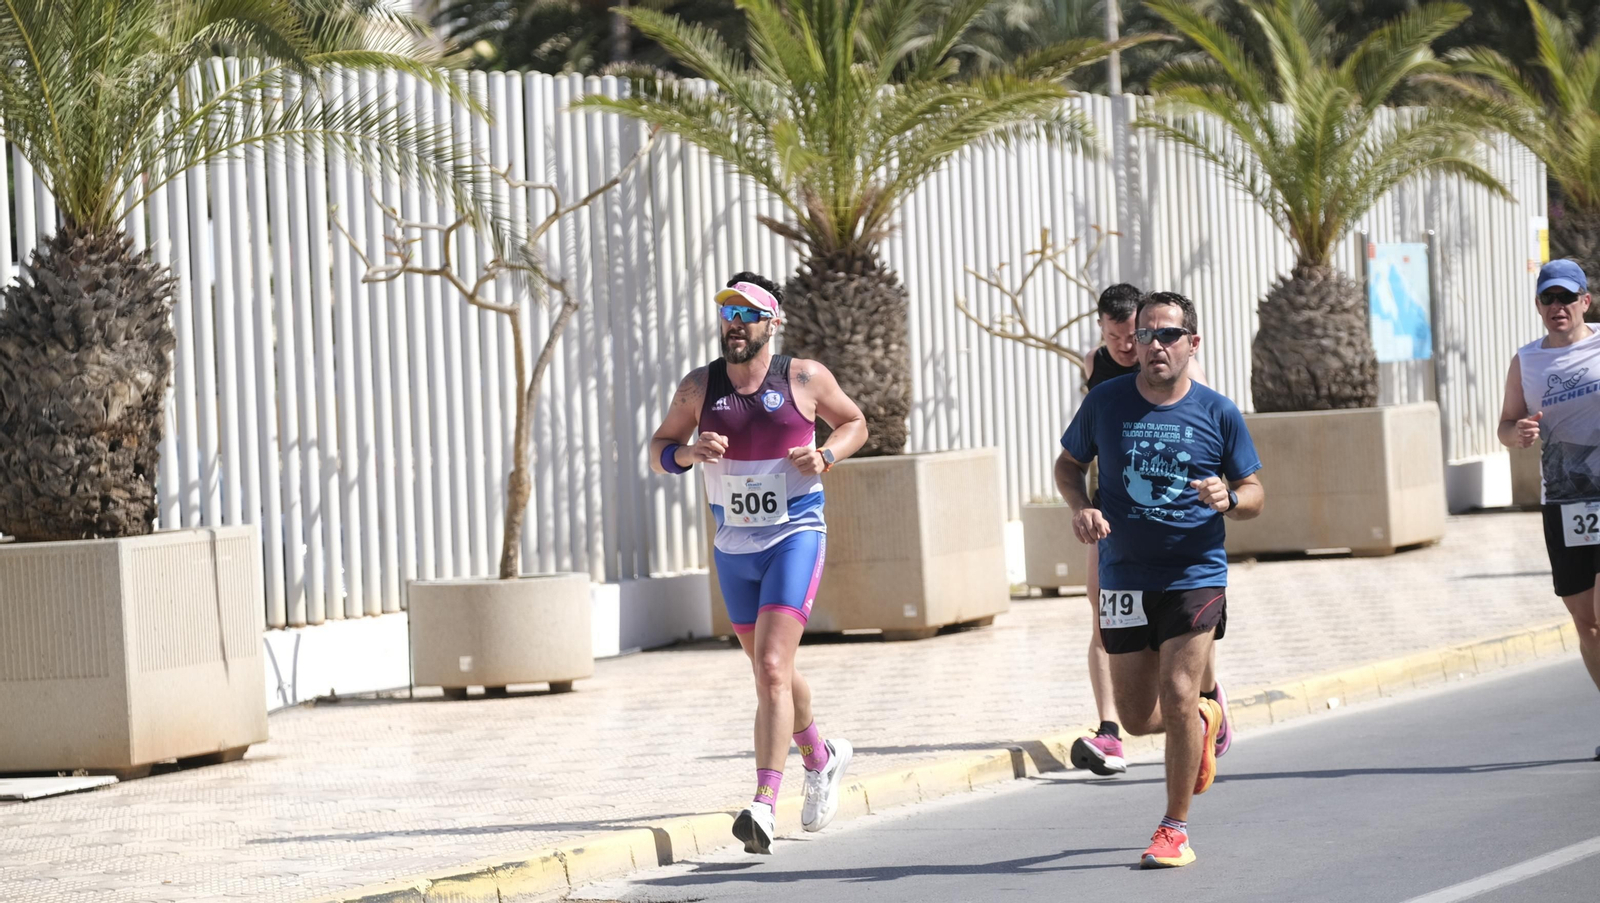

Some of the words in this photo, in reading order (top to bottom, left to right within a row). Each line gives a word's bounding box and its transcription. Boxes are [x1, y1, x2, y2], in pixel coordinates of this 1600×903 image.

[1541, 382, 1600, 407] MICHELI
[1147, 423, 1180, 431] SILVESTRE
[730, 491, 778, 515] 506
[1572, 513, 1600, 534] 32
[1100, 593, 1134, 616] 219
